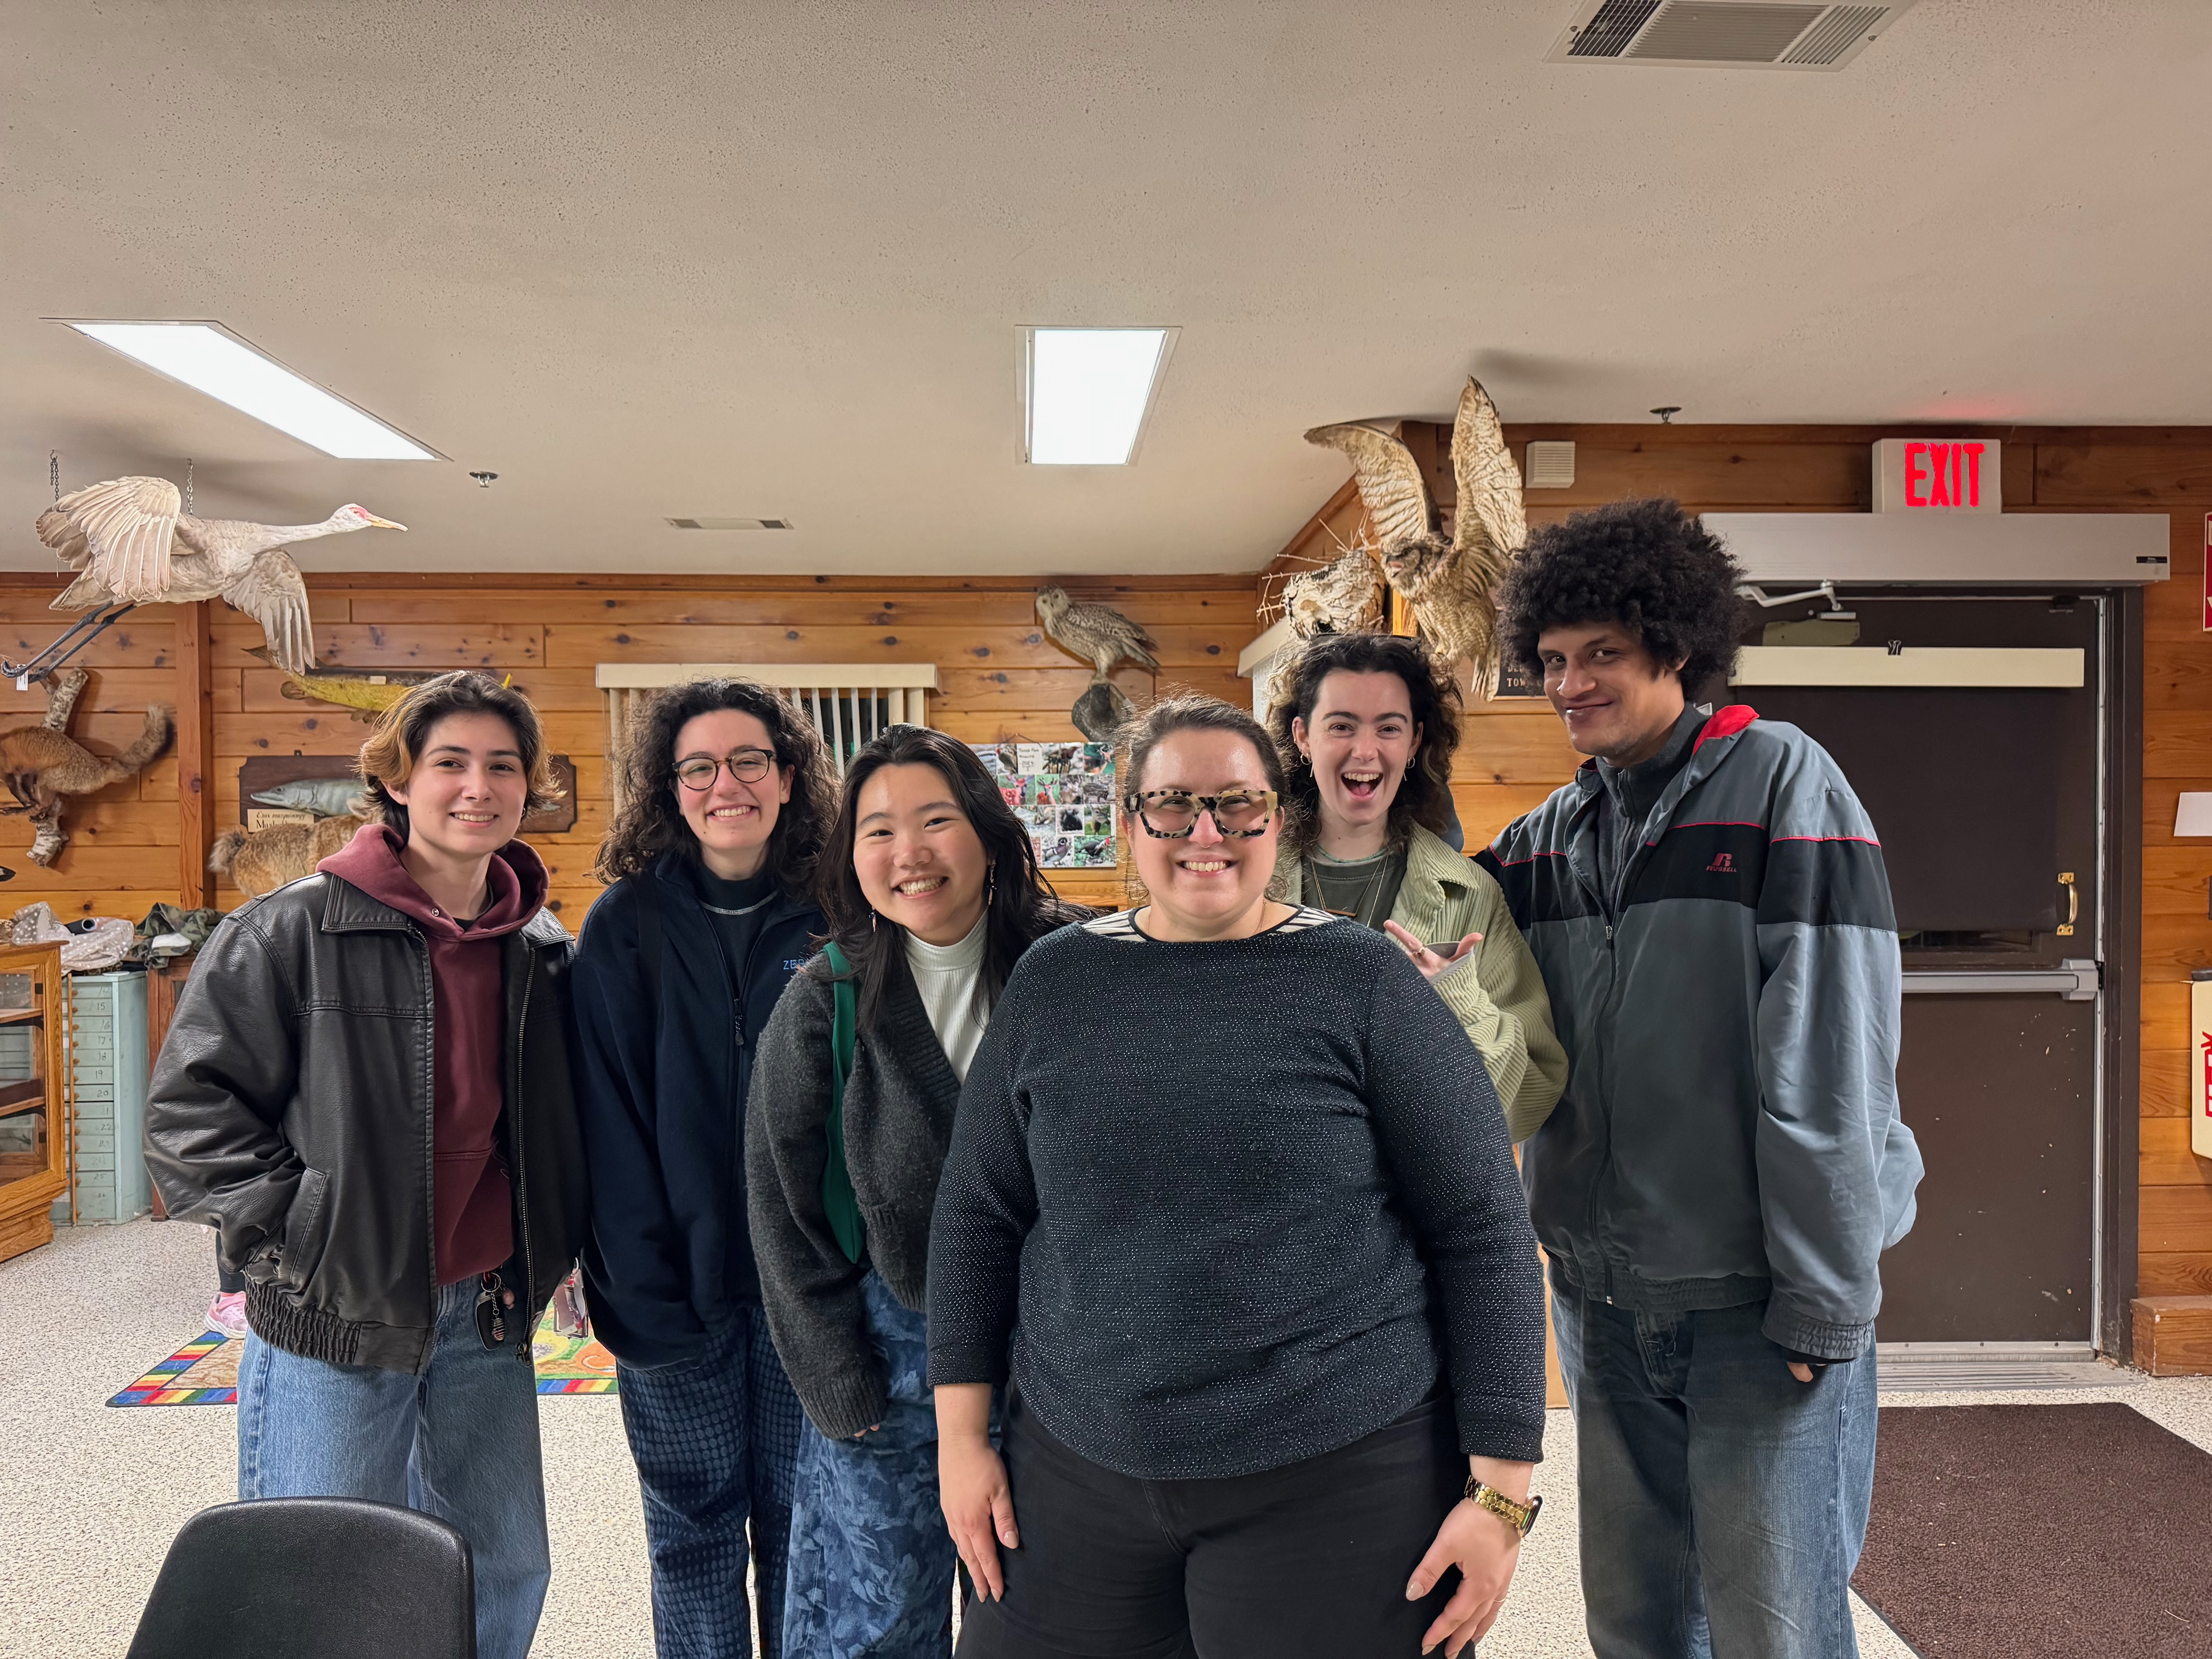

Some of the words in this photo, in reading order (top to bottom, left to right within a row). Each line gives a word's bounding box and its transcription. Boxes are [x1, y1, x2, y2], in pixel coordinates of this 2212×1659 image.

[1905, 443, 1985, 507] EXIT
[97, 1002, 105, 1011] 15
[98, 1036, 105, 1044] 17
[96, 1070, 103, 1080] 19
[97, 1089, 109, 1097] 20
